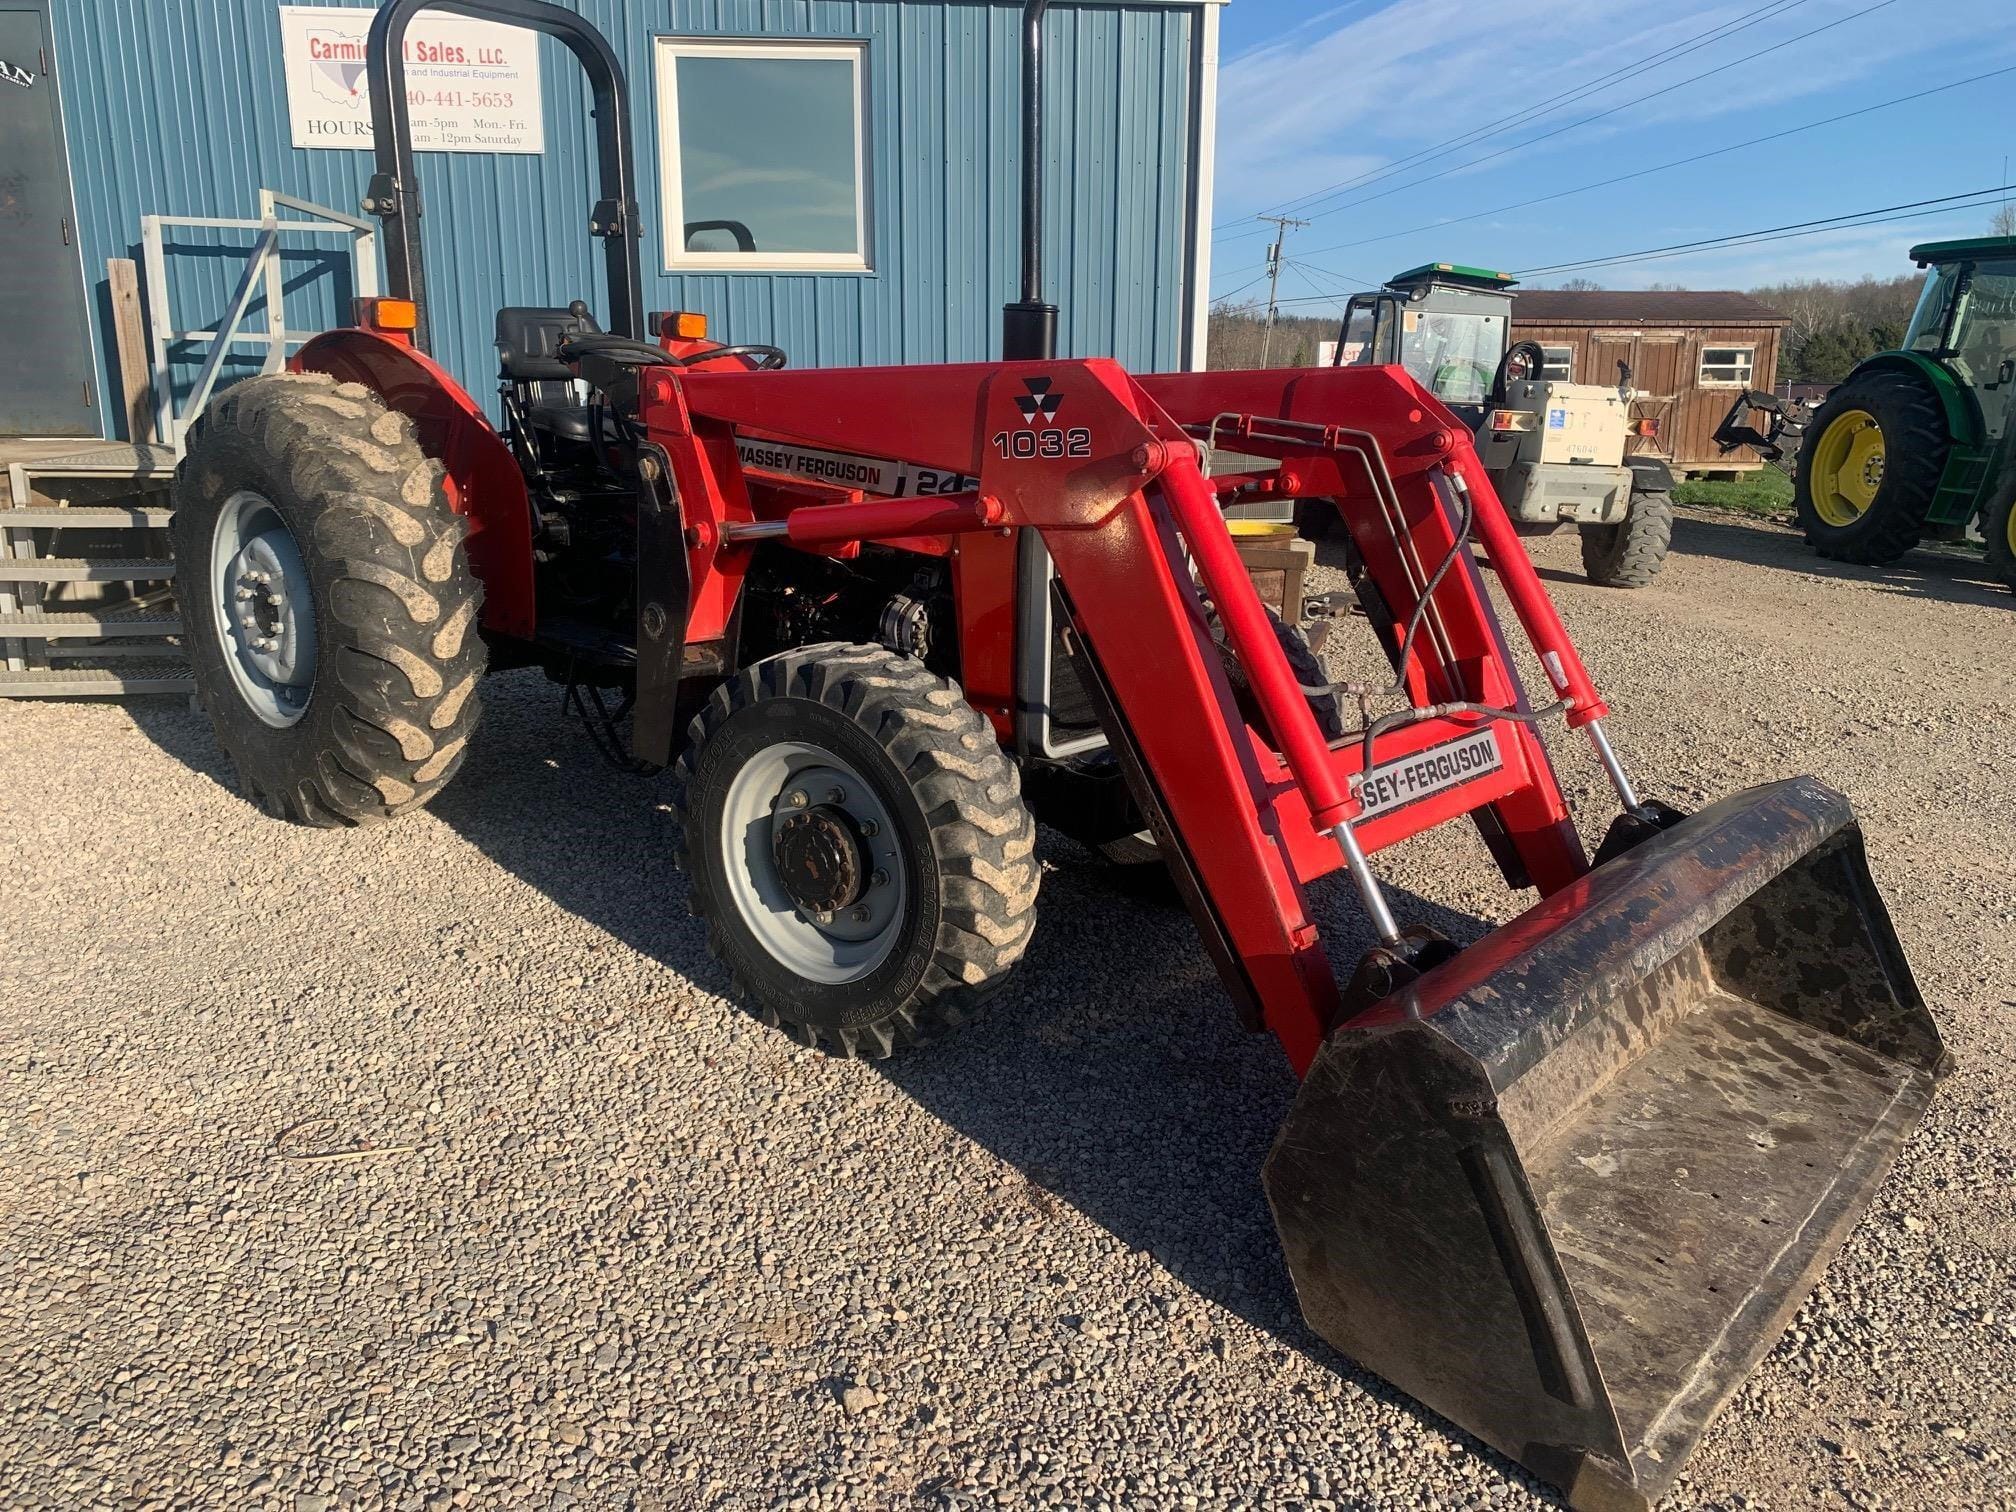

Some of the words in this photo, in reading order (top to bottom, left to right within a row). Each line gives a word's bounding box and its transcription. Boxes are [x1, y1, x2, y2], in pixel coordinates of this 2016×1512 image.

[416, 40, 471, 66] Sales,
[478, 48, 508, 65] LLC.
[411, 68, 428, 77] and
[430, 69, 470, 78] Industrial
[472, 69, 519, 80] Equipment
[406, 90, 513, 108] 40-441-5653
[474, 134, 522, 145] Saturday
[992, 427, 1091, 459] 1032
[797, 455, 880, 485] FERGUSON
[917, 843, 938, 950] PREMIUM
[893, 953, 926, 996] SKID
